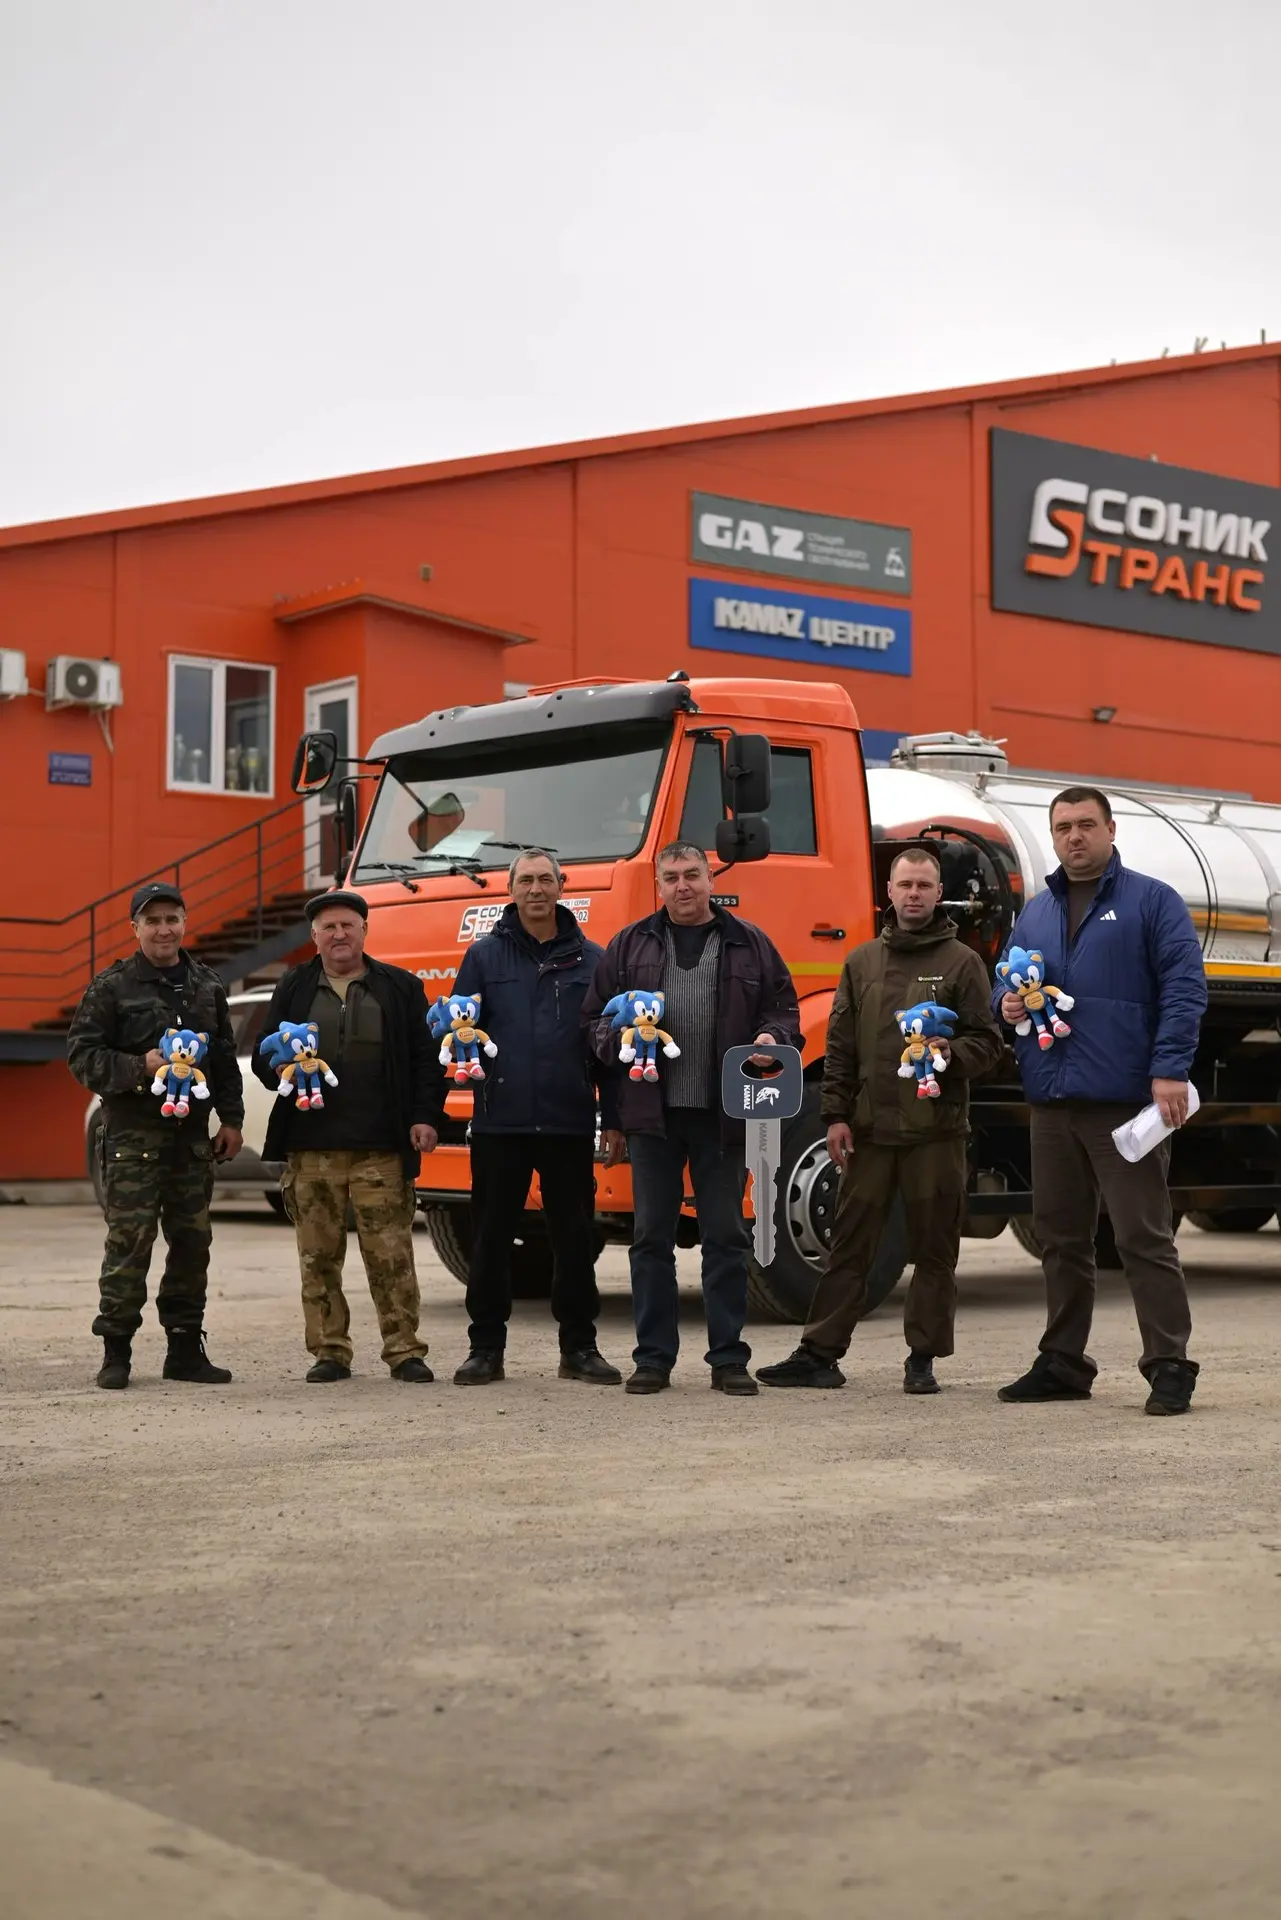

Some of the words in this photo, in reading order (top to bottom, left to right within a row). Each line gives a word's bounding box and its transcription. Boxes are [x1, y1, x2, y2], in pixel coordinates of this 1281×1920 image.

[699, 512, 805, 562] GAZ
[1087, 488, 1271, 563] СОНИК
[1083, 540, 1265, 613] ТРАНС
[714, 597, 805, 639] KAMAZ
[809, 616, 896, 650] ЦЕНТР
[480, 906, 504, 918] СОН
[743, 1084, 751, 1110] KAMAZ
[759, 1122, 767, 1153] KAMAZ
